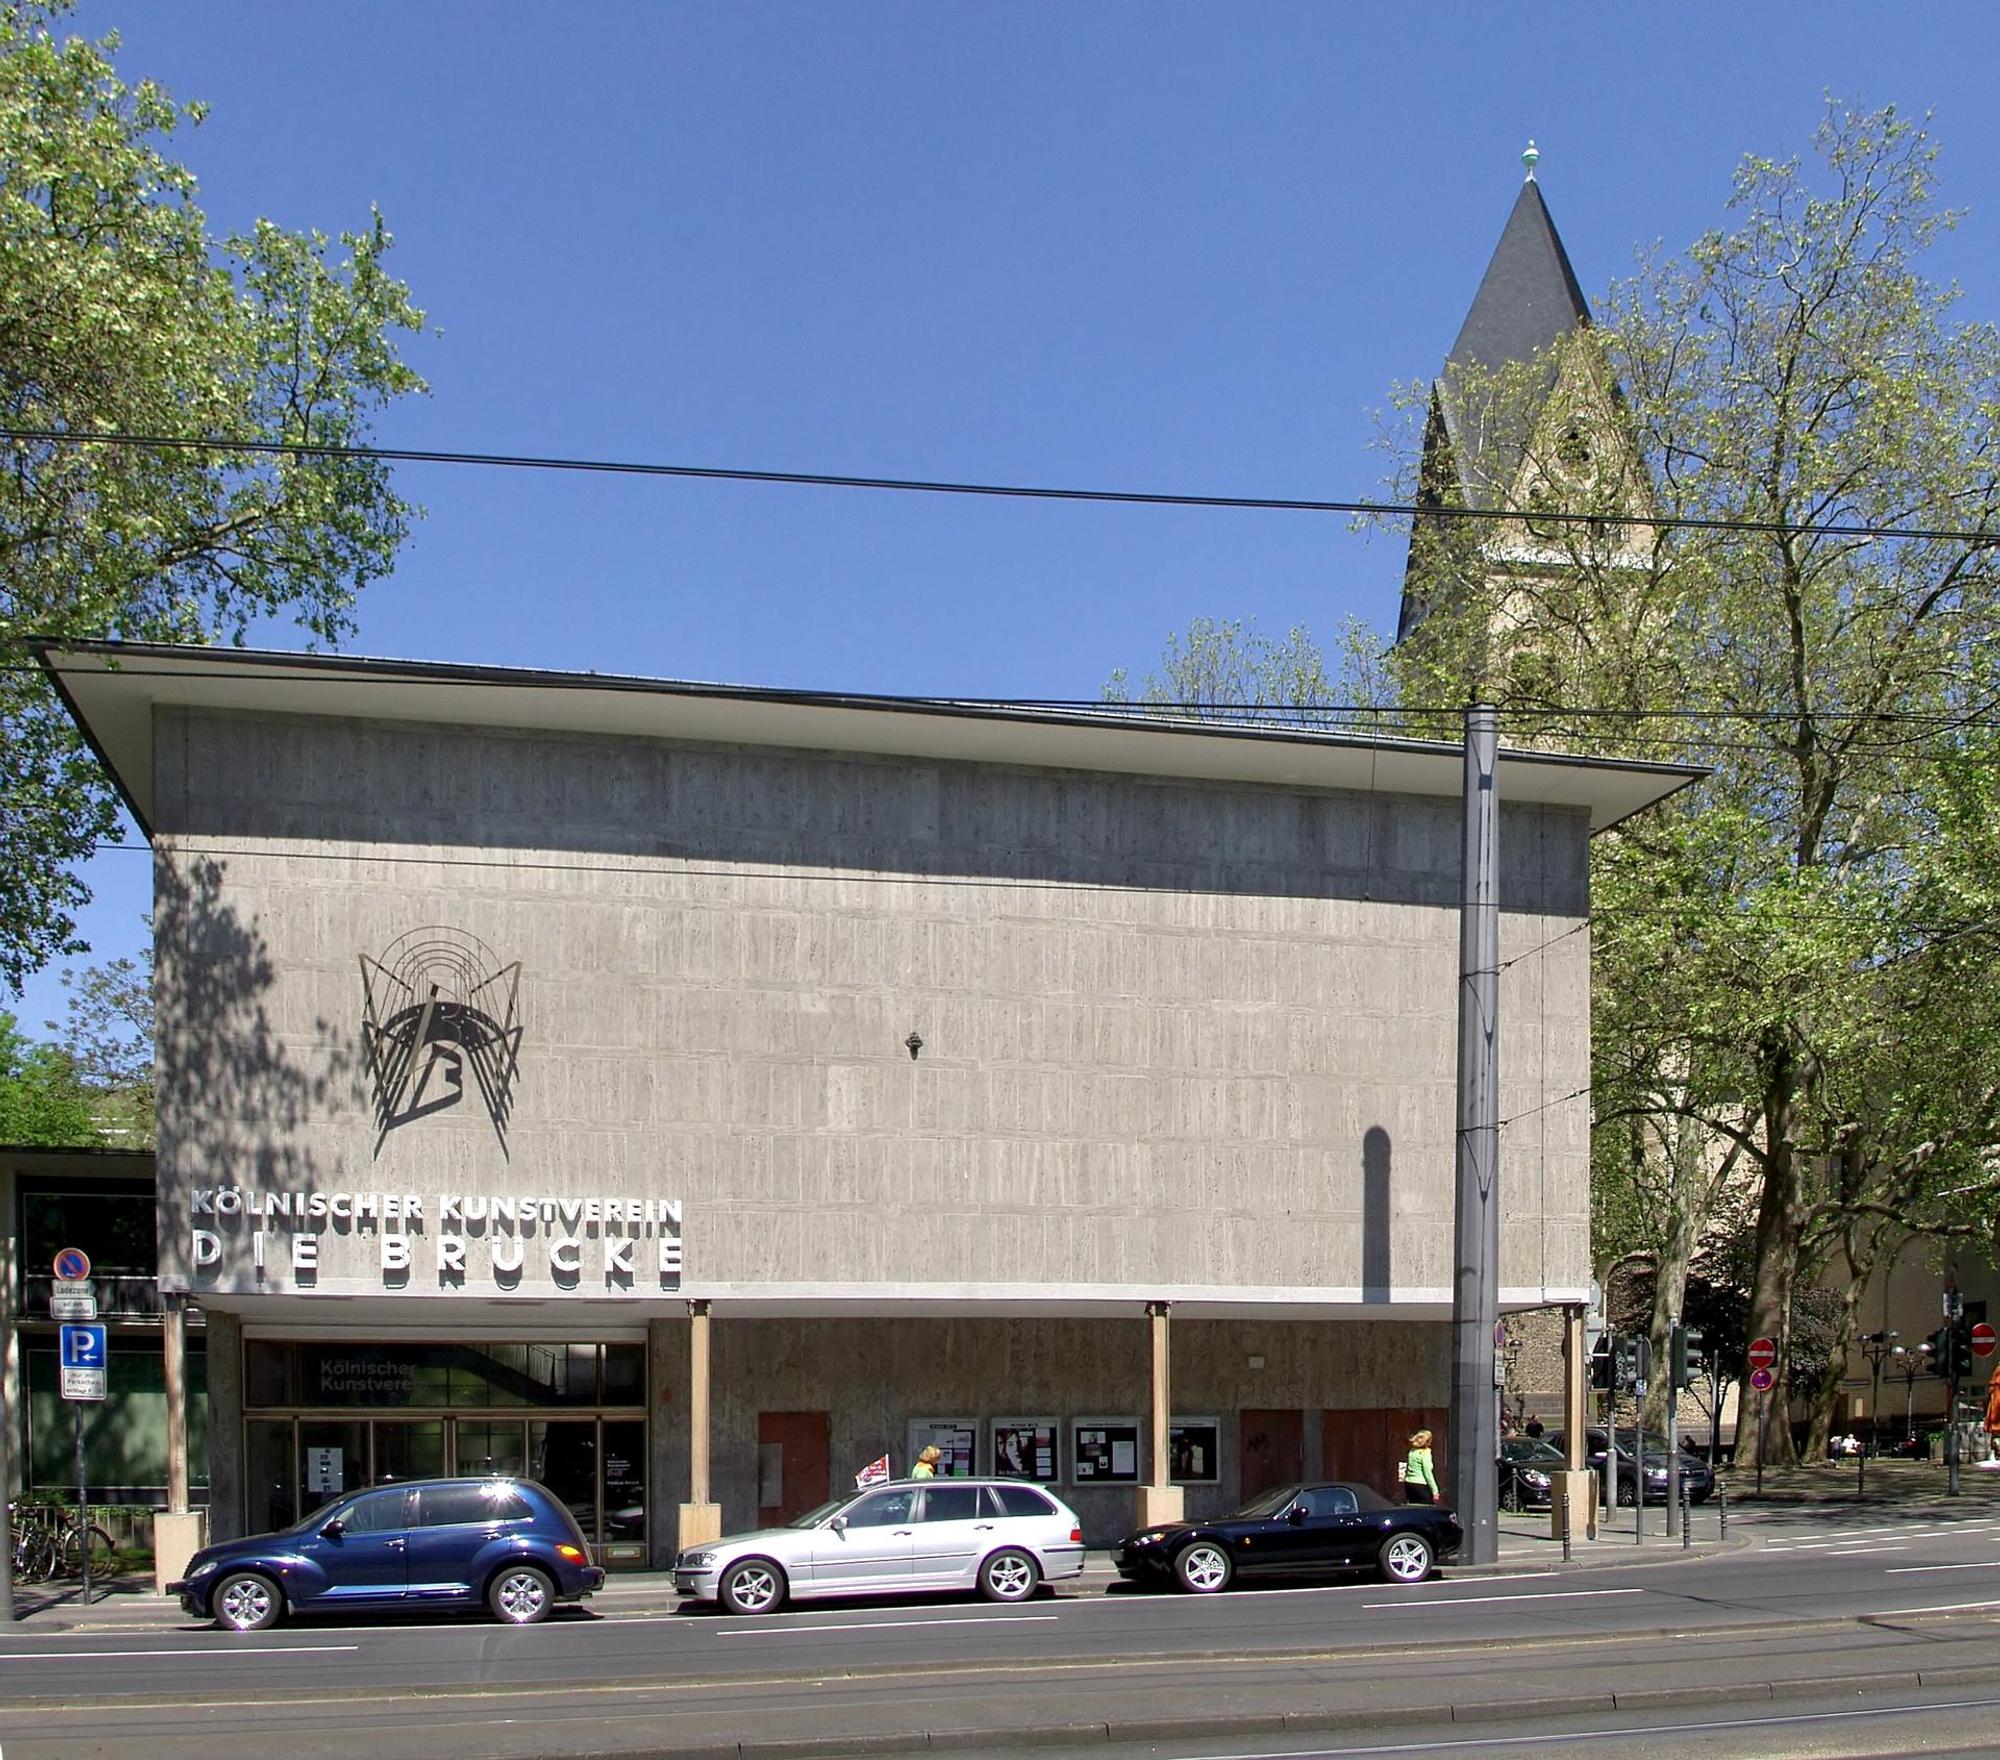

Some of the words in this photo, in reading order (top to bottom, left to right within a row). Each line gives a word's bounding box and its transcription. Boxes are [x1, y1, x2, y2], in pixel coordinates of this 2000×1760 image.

[191, 1185, 423, 1218] KÖLNISCHER
[439, 1195, 683, 1222] KUNSTVEREIN
[192, 1229, 318, 1268] DIE
[380, 1234, 683, 1272] BRÜCKE
[72, 1331, 95, 1362] P
[320, 1359, 417, 1375] Kölnischer
[320, 1376, 430, 1392] Kunstvere
